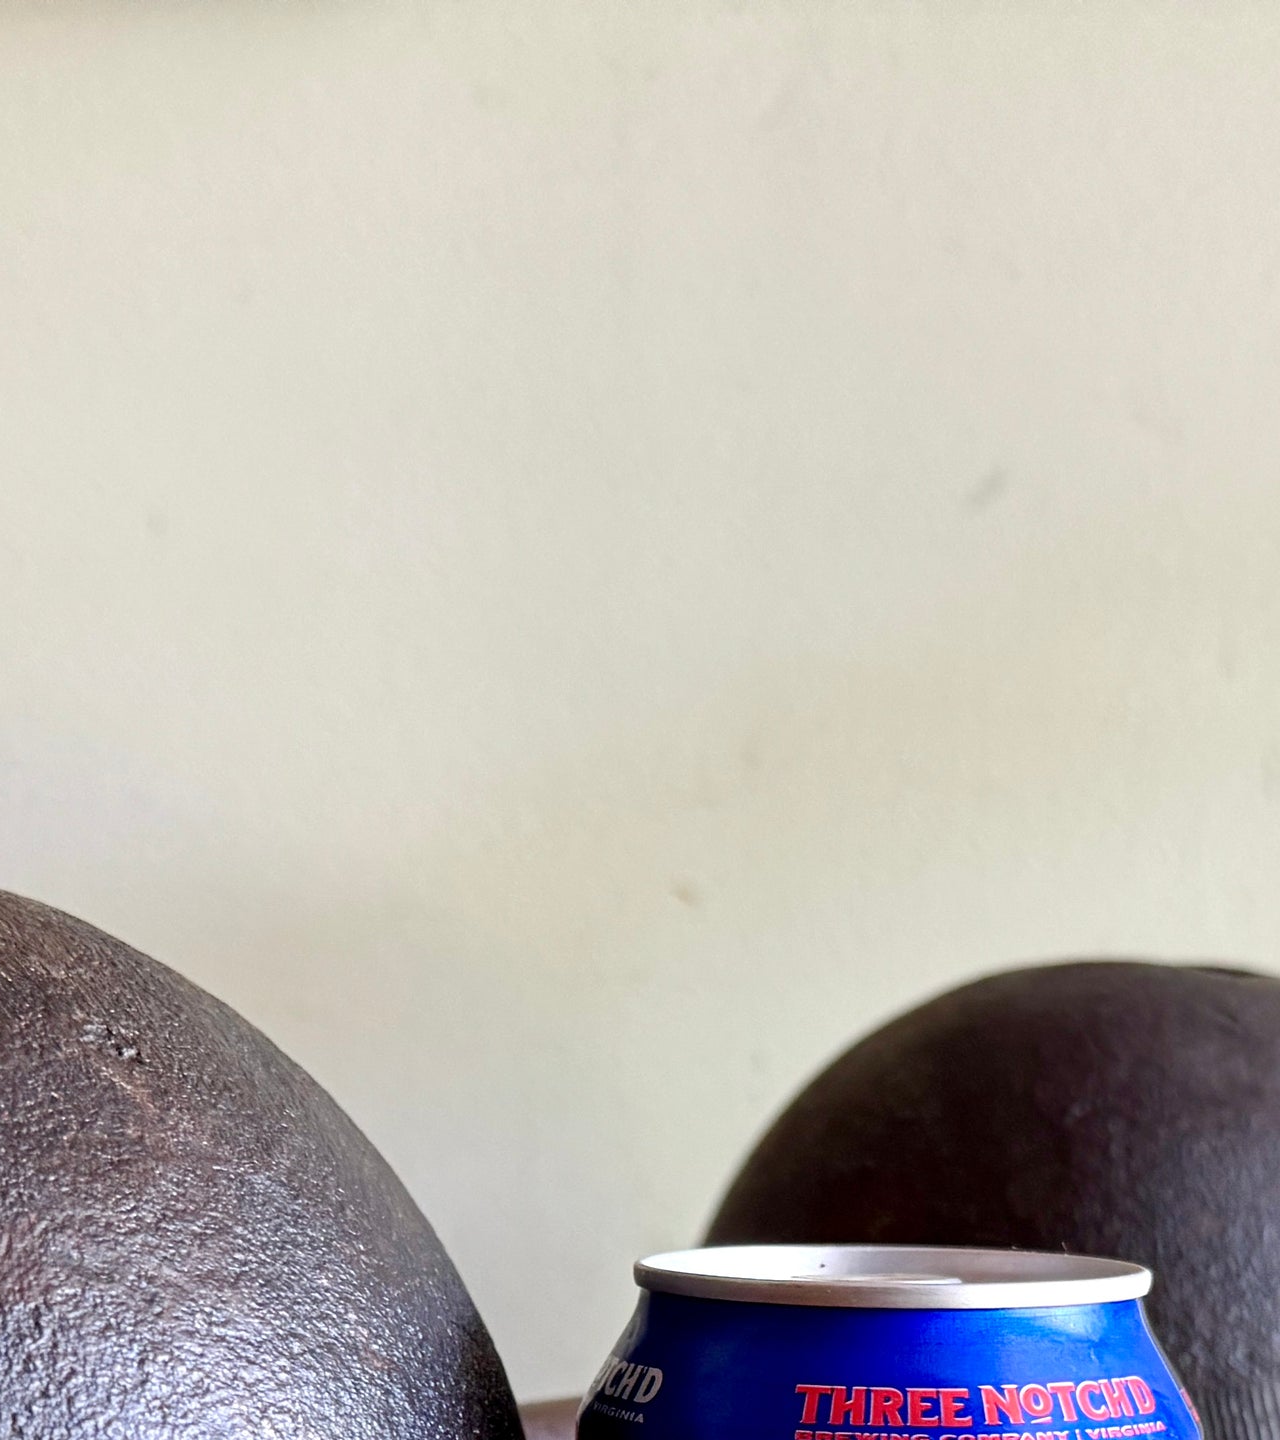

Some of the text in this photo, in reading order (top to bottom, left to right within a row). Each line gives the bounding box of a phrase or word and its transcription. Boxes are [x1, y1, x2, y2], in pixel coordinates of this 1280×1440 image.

[795, 1384, 973, 1427] THREE
[978, 1375, 1156, 1425] NOTCH'D
[1085, 1420, 1167, 1440] VIRGINIA
